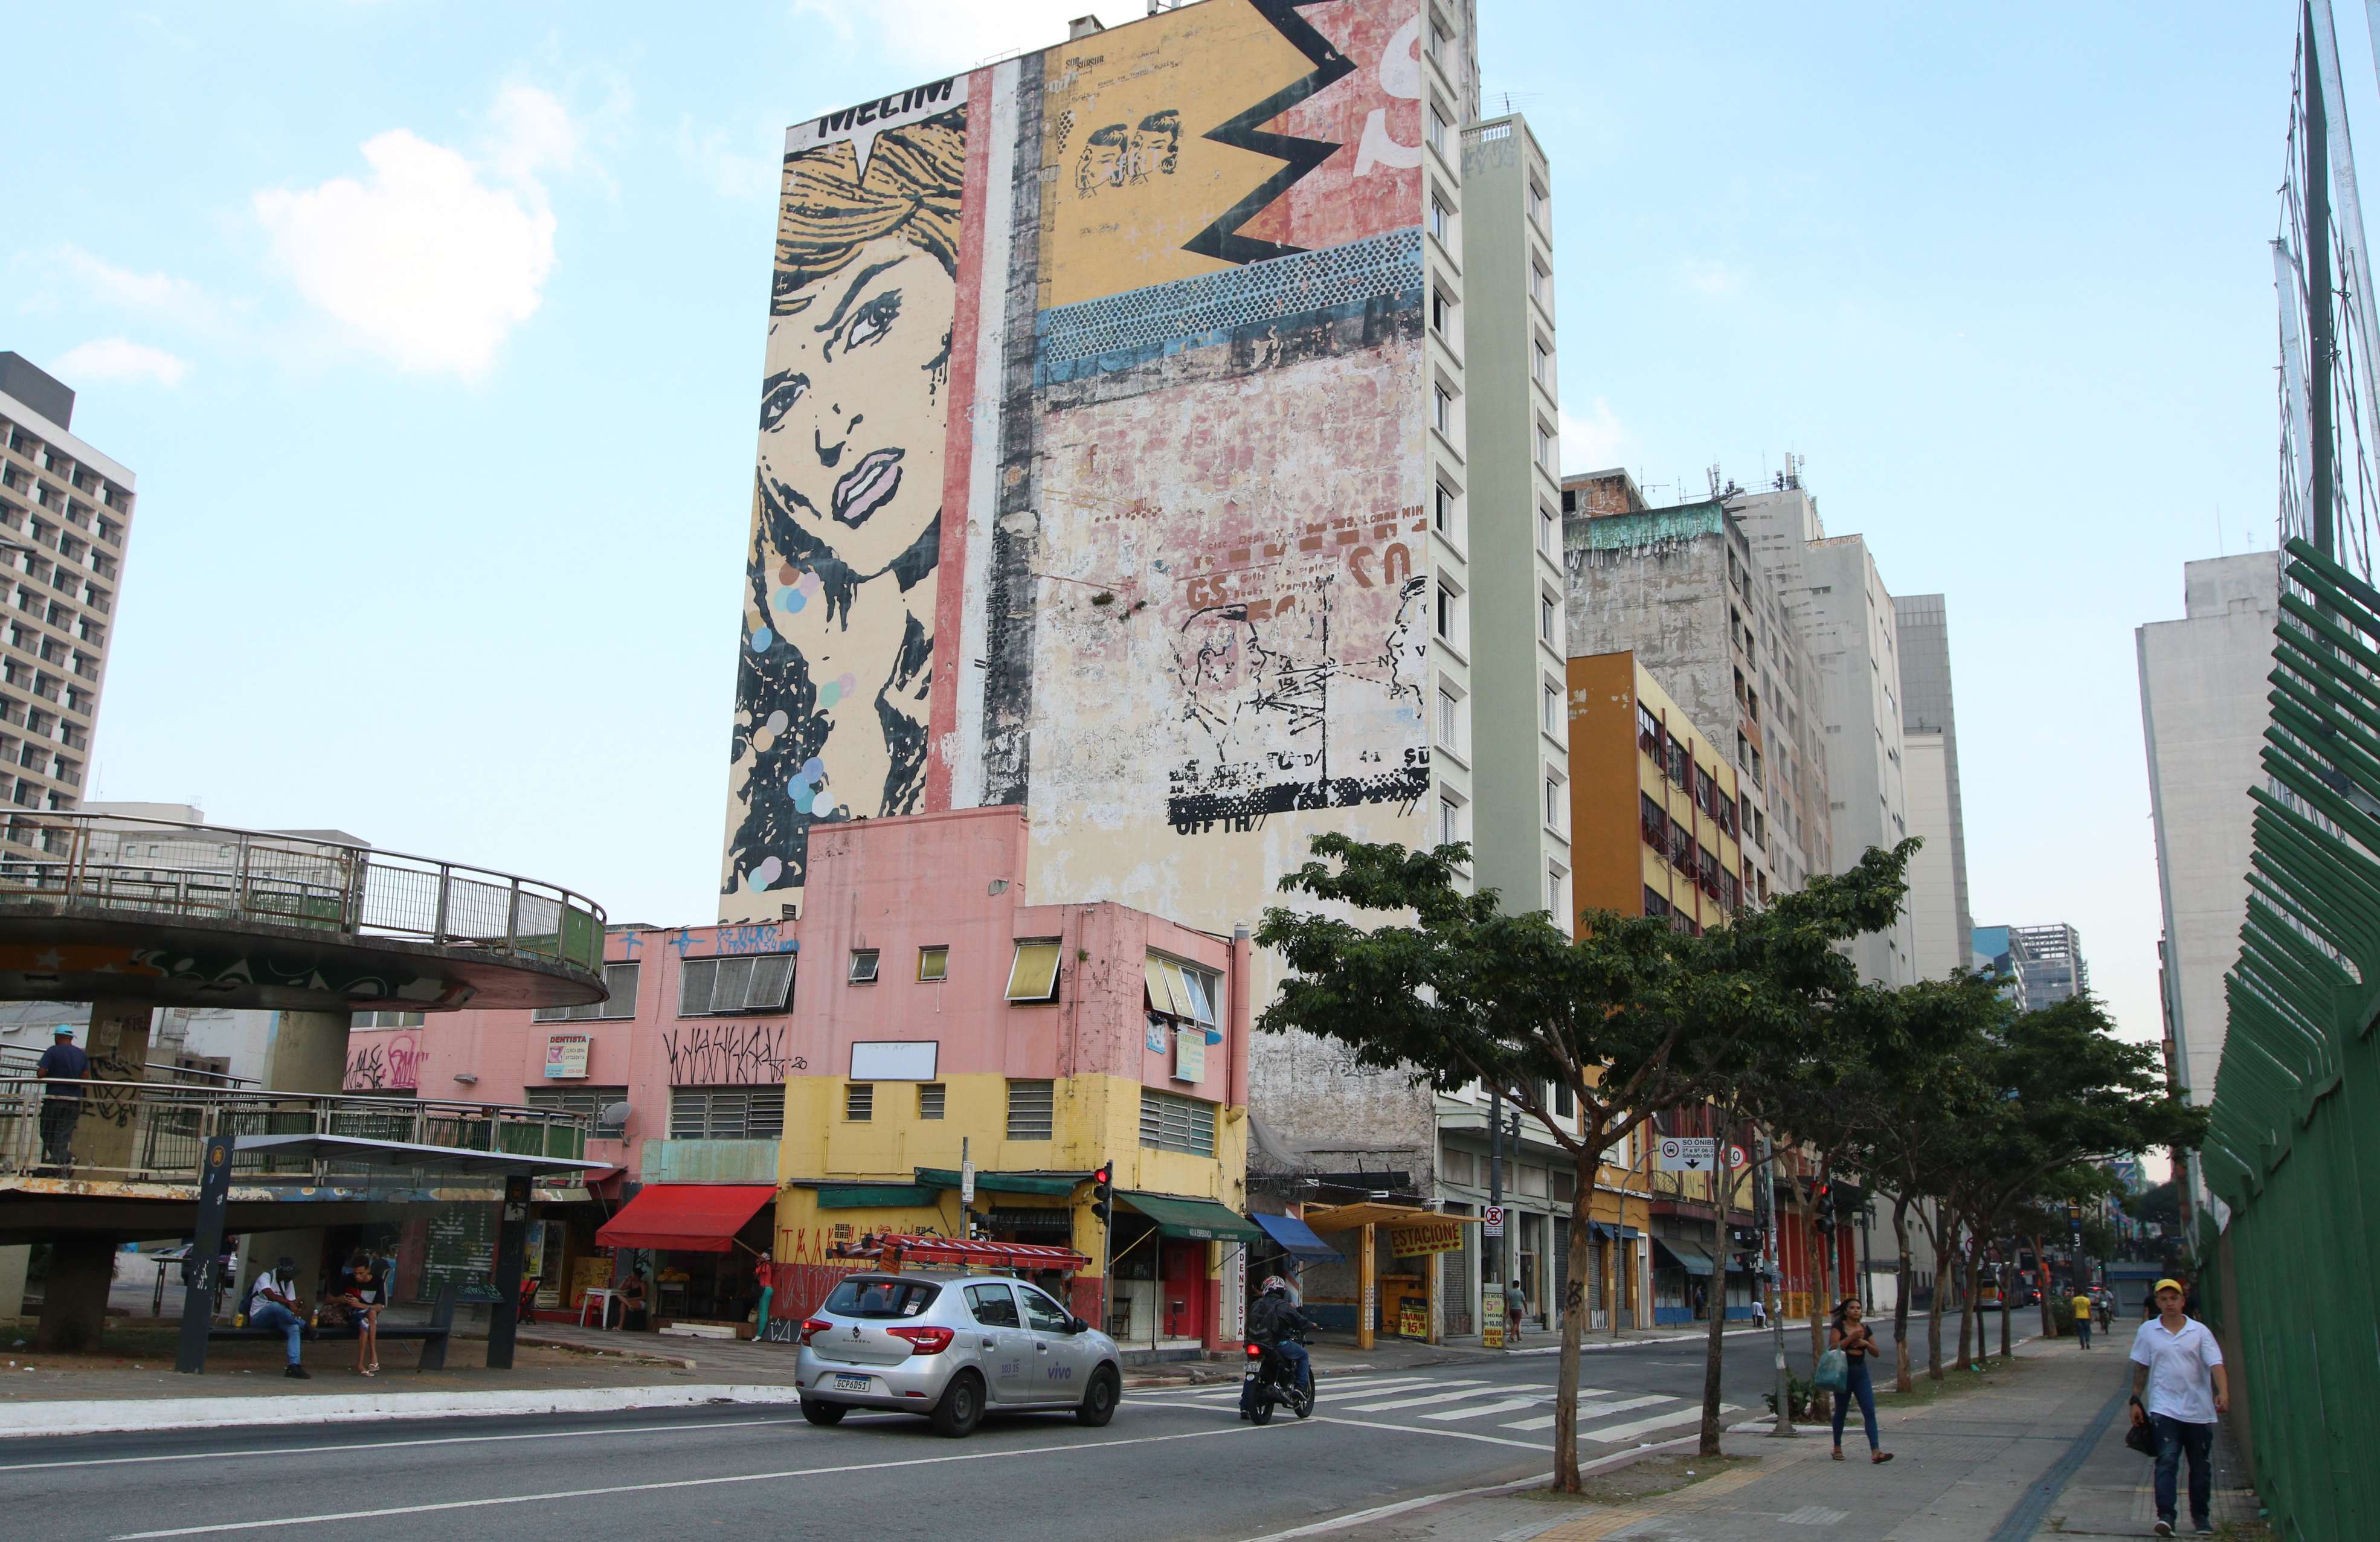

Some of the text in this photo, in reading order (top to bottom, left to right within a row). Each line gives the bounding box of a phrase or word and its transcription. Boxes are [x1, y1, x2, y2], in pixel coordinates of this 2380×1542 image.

[819, 78, 954, 138] MELIM
[550, 1035, 587, 1044] DENTISTA
[1391, 1222, 1460, 1247] ESTACIONE
[1002, 1364, 1011, 1373] 103
[1048, 1361, 1072, 1380] vivo
